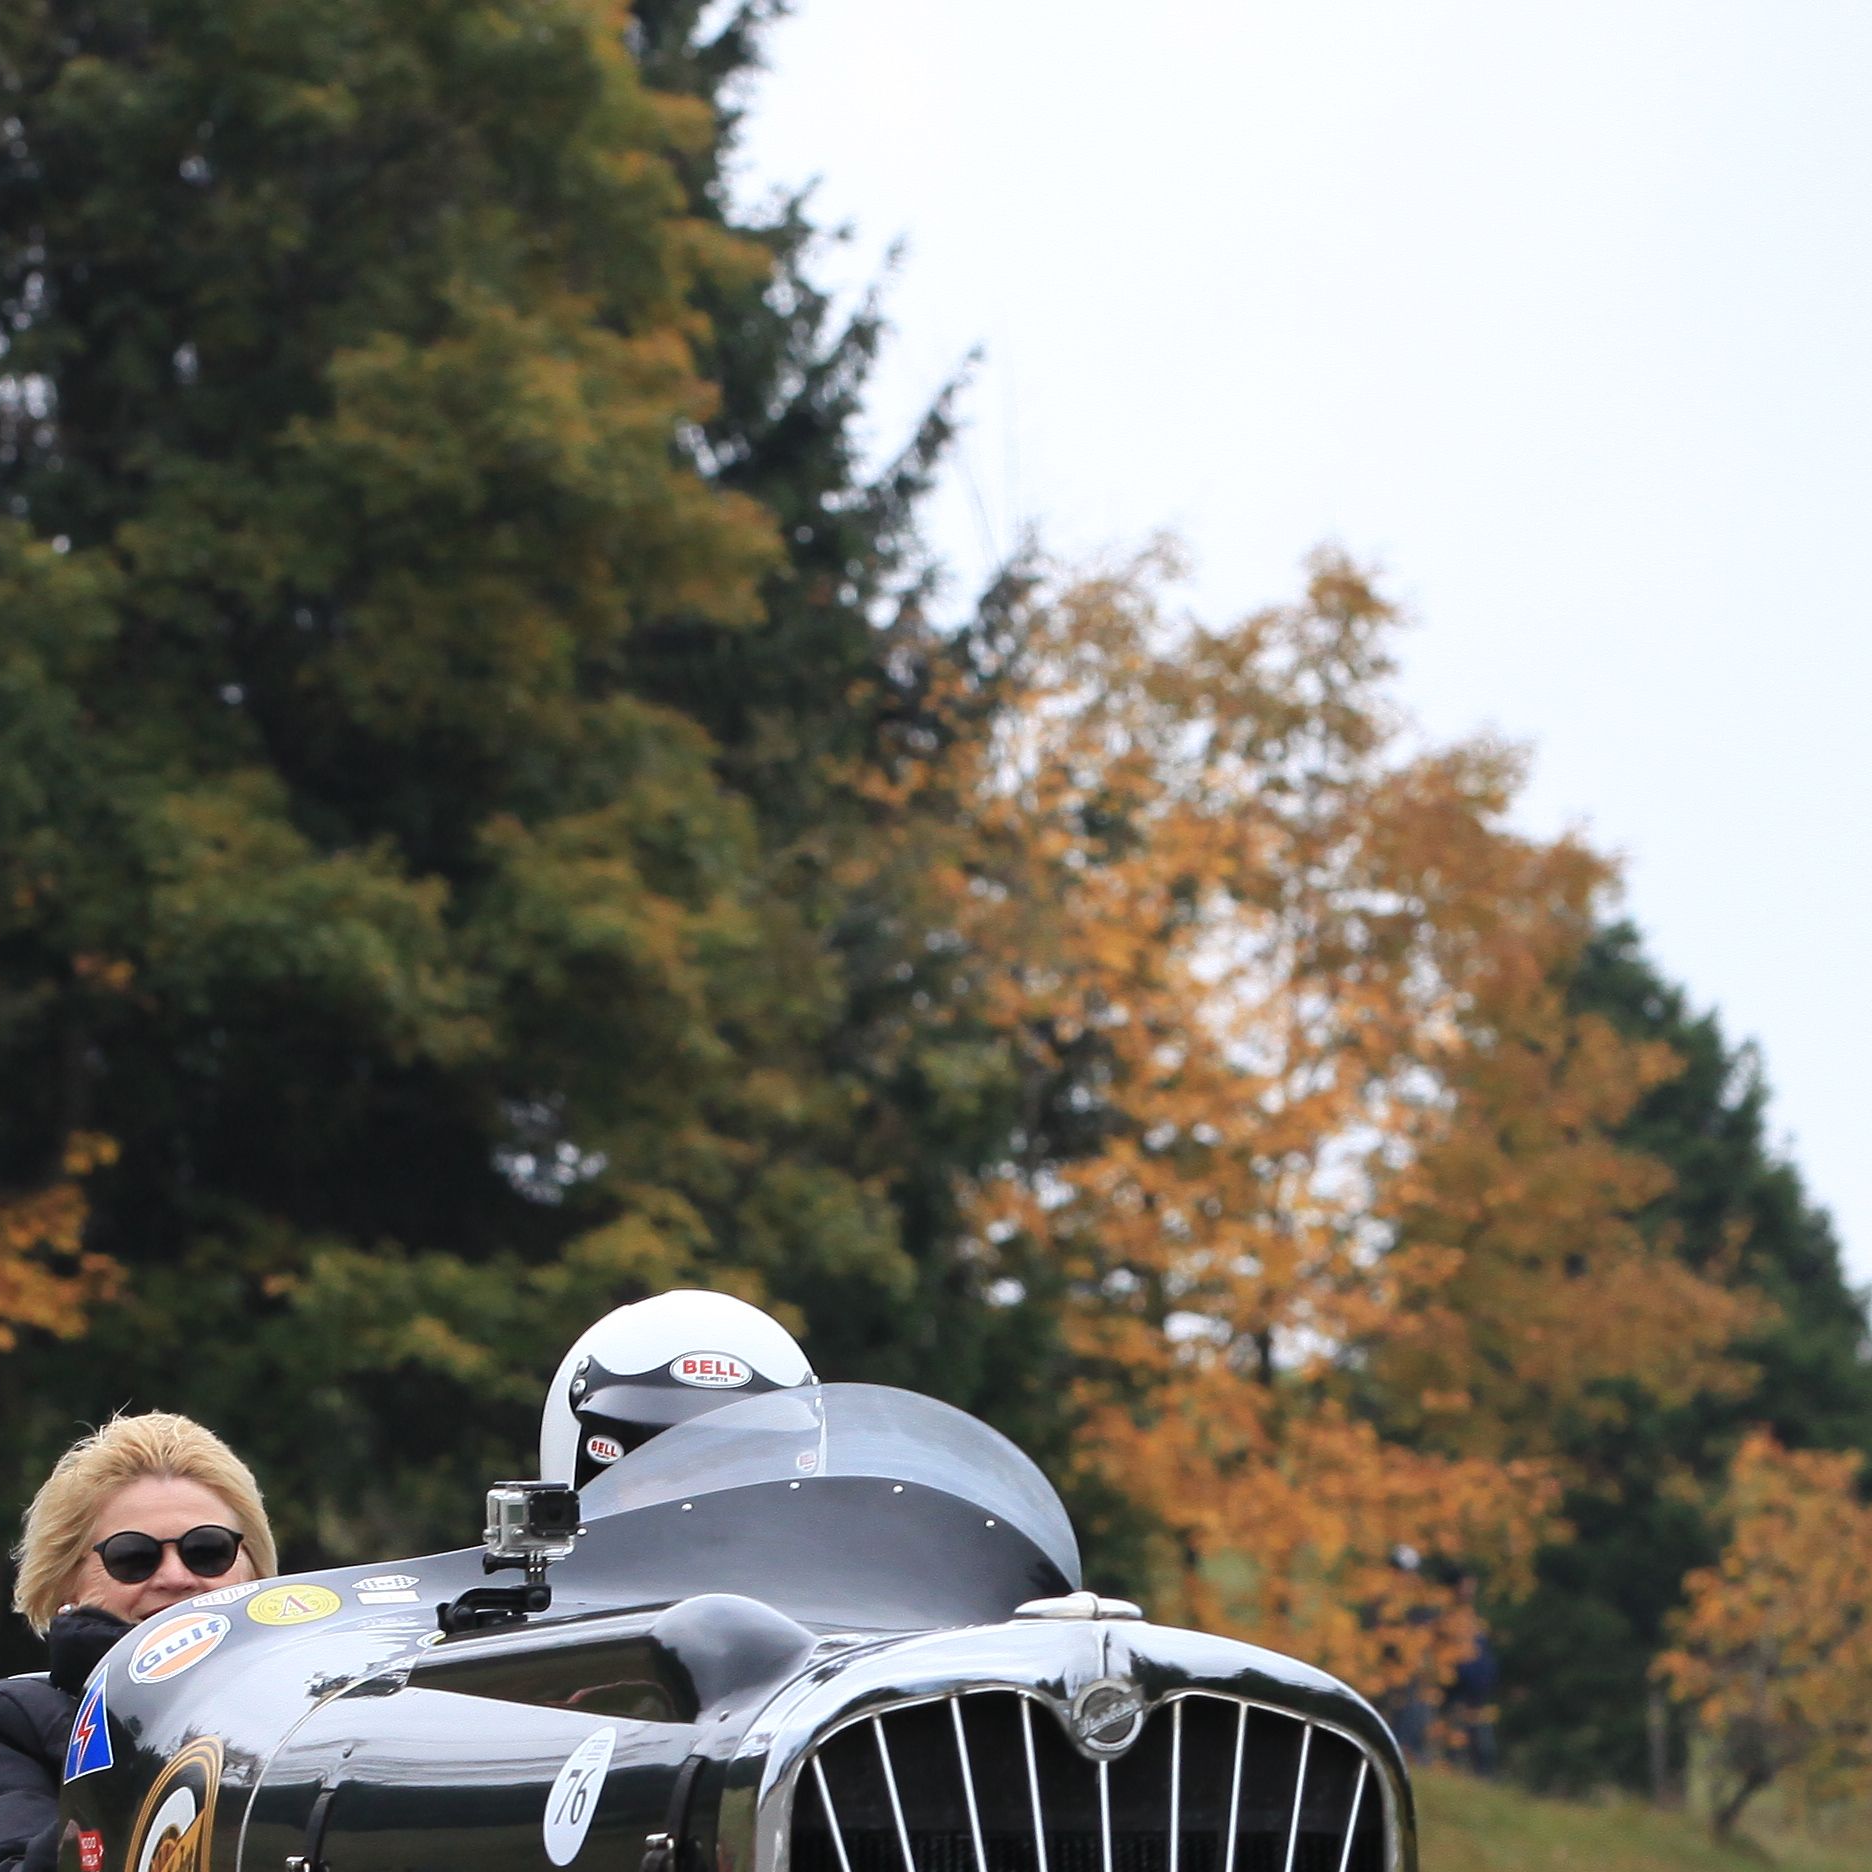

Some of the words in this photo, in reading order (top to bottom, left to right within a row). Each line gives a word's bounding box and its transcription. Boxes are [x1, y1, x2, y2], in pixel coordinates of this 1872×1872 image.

[683, 1360, 741, 1377] BELL
[591, 1441, 616, 1457] BELL
[136, 1620, 221, 1673] Gulf
[554, 1768, 598, 1825] 76
